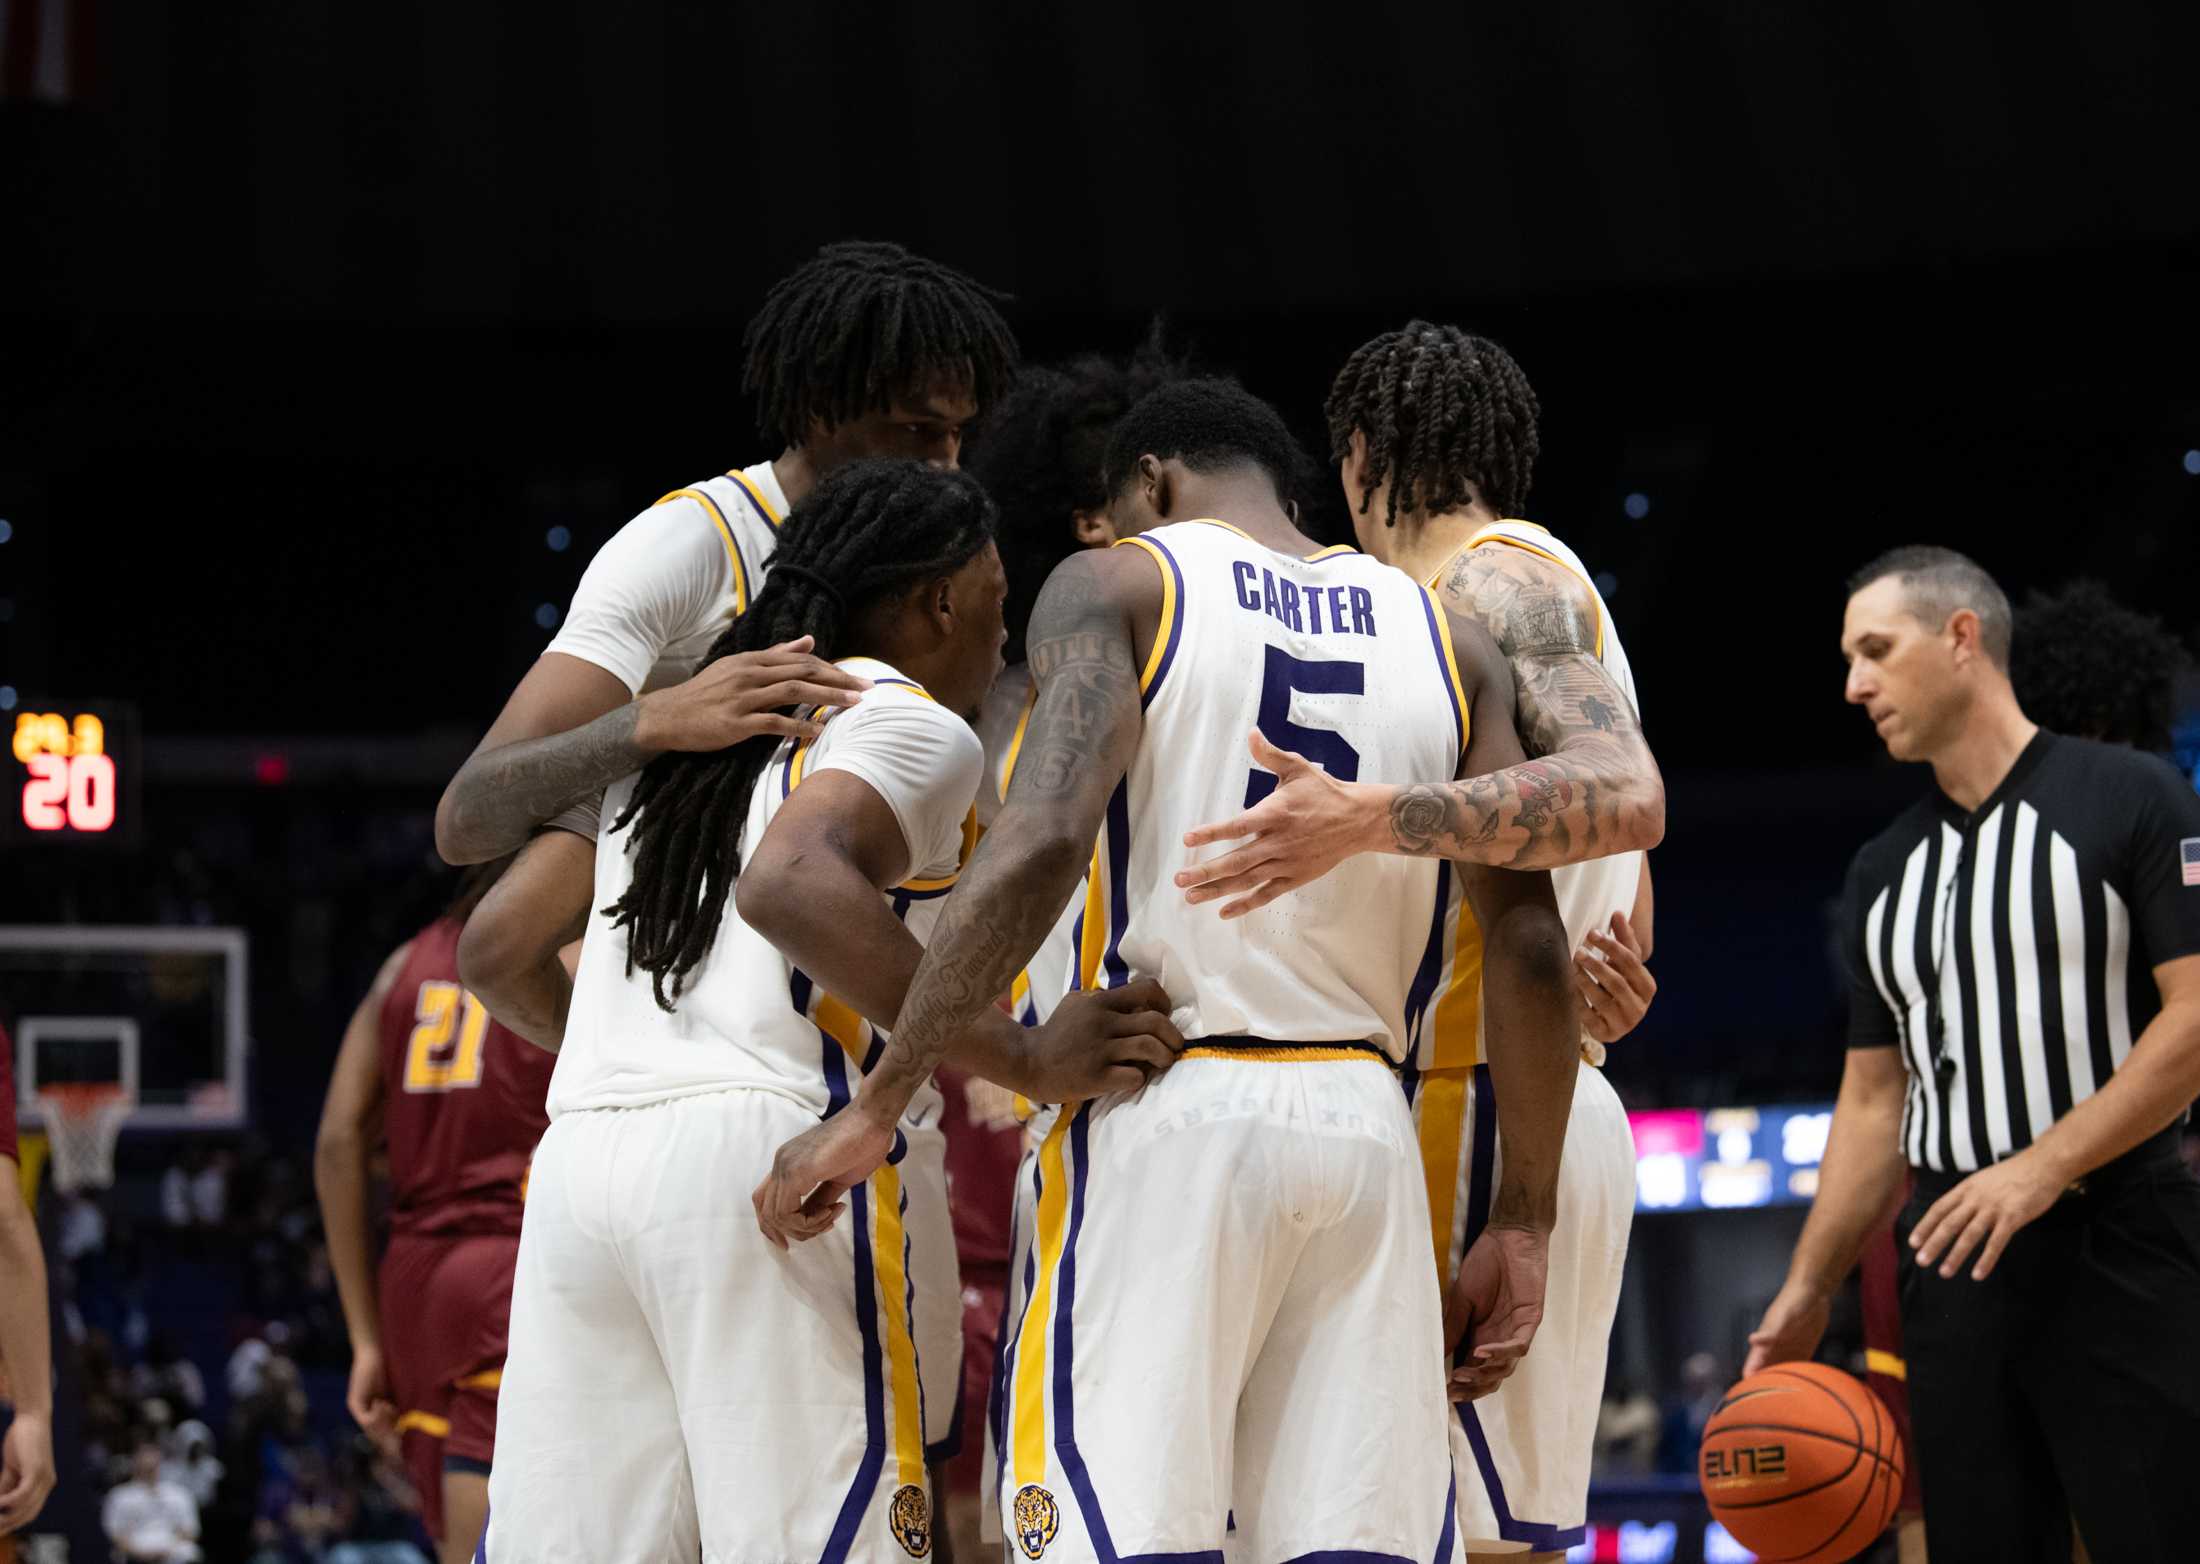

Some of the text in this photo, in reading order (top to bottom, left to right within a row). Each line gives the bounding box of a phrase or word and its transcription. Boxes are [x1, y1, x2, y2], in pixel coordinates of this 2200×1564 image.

[1233, 561, 1377, 637] CARTER
[1245, 644, 1365, 808] 5
[22, 753, 116, 831] 20
[402, 979, 488, 1094] 21
